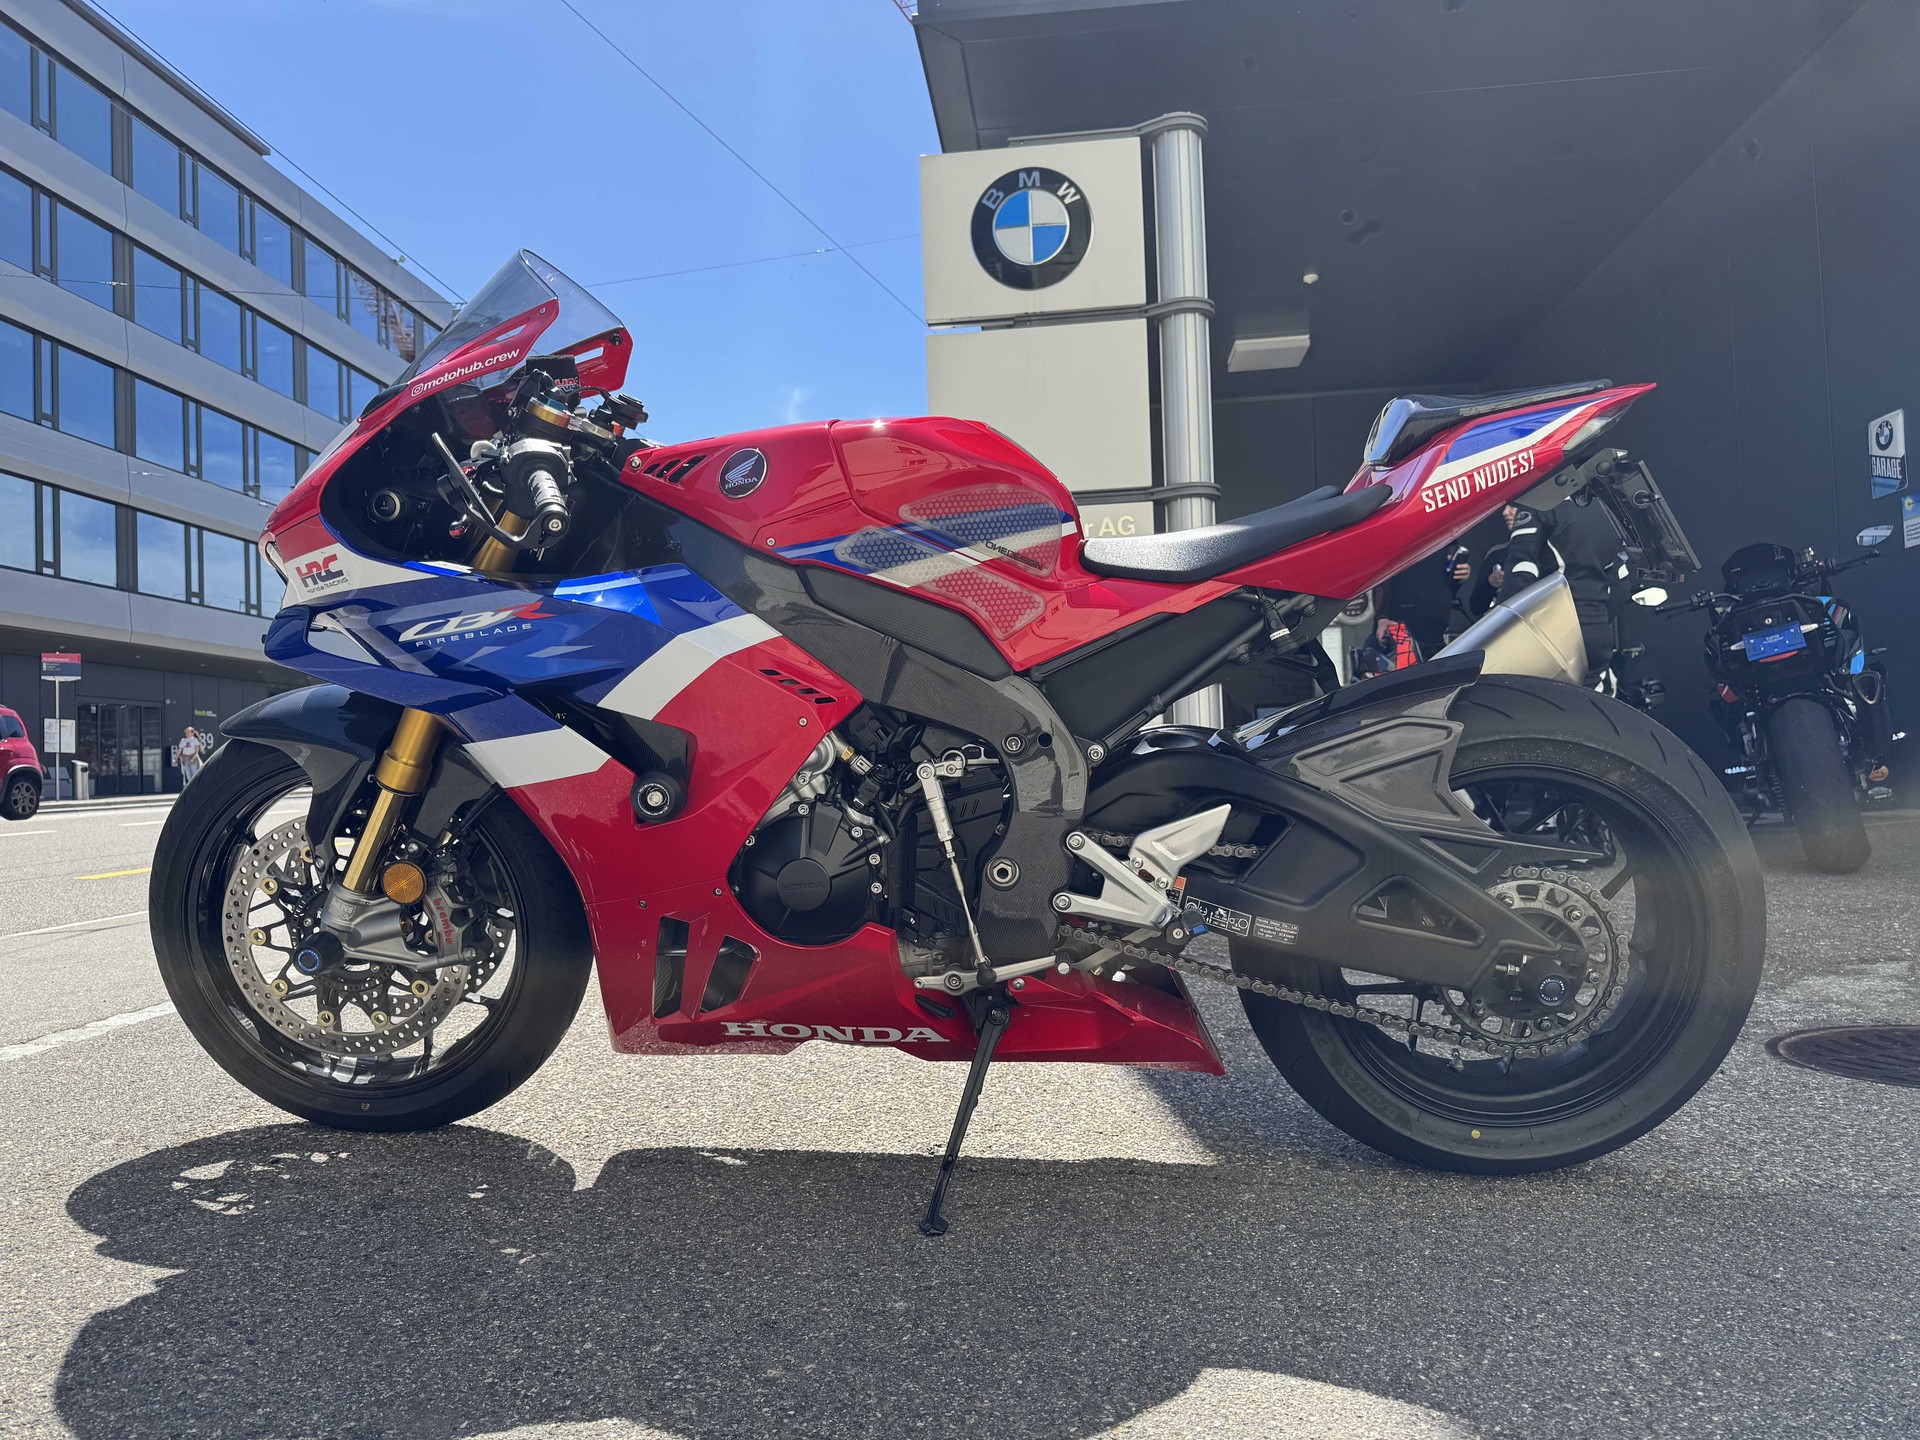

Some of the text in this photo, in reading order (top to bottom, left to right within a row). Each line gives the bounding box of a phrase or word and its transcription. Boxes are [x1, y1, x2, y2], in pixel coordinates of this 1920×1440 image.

[981, 170, 1081, 210] BMW
[1421, 450, 1535, 513] SEND NUDES!
[1872, 456, 1902, 479] GARAGE
[725, 477, 758, 489] HONDA
[1098, 515, 1136, 536] AG
[985, 541, 1043, 570] ONEDESIGN
[295, 554, 344, 588] HRC
[398, 601, 560, 642] CBR
[416, 623, 532, 647] FIREBLADE
[433, 897, 454, 945] brembo
[720, 1021, 950, 1042] HONDA
